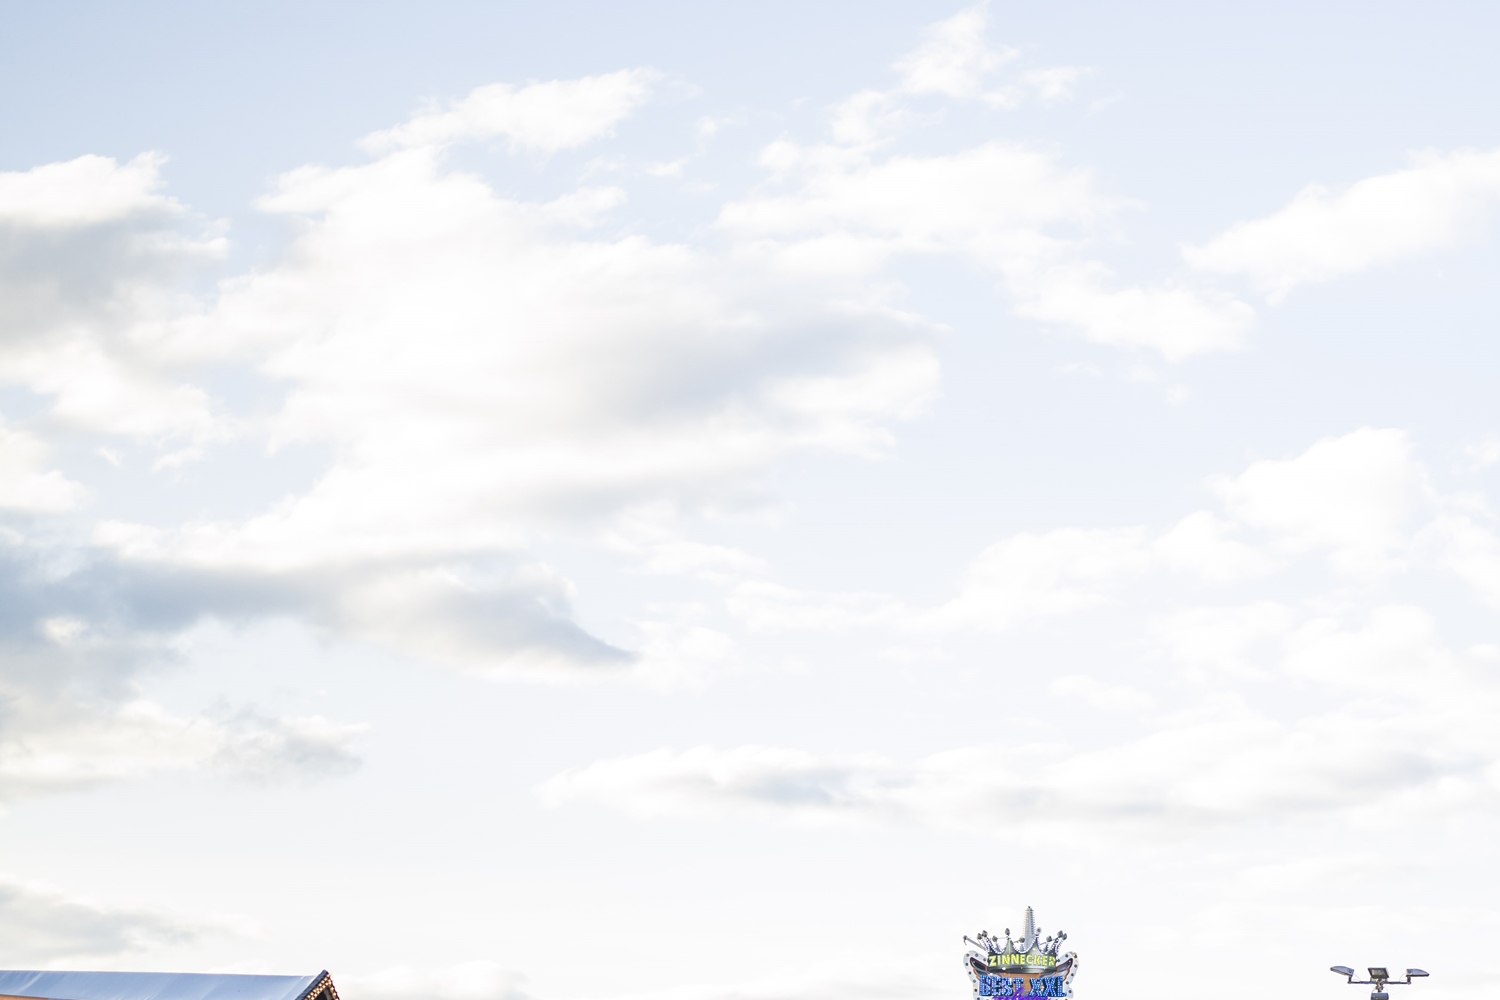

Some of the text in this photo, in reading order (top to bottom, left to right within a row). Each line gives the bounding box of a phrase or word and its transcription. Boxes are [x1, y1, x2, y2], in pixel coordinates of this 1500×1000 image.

[988, 953, 1056, 967] ZINNECKER
[980, 975, 1024, 997] BEST
[1028, 976, 1067, 997] XXL
